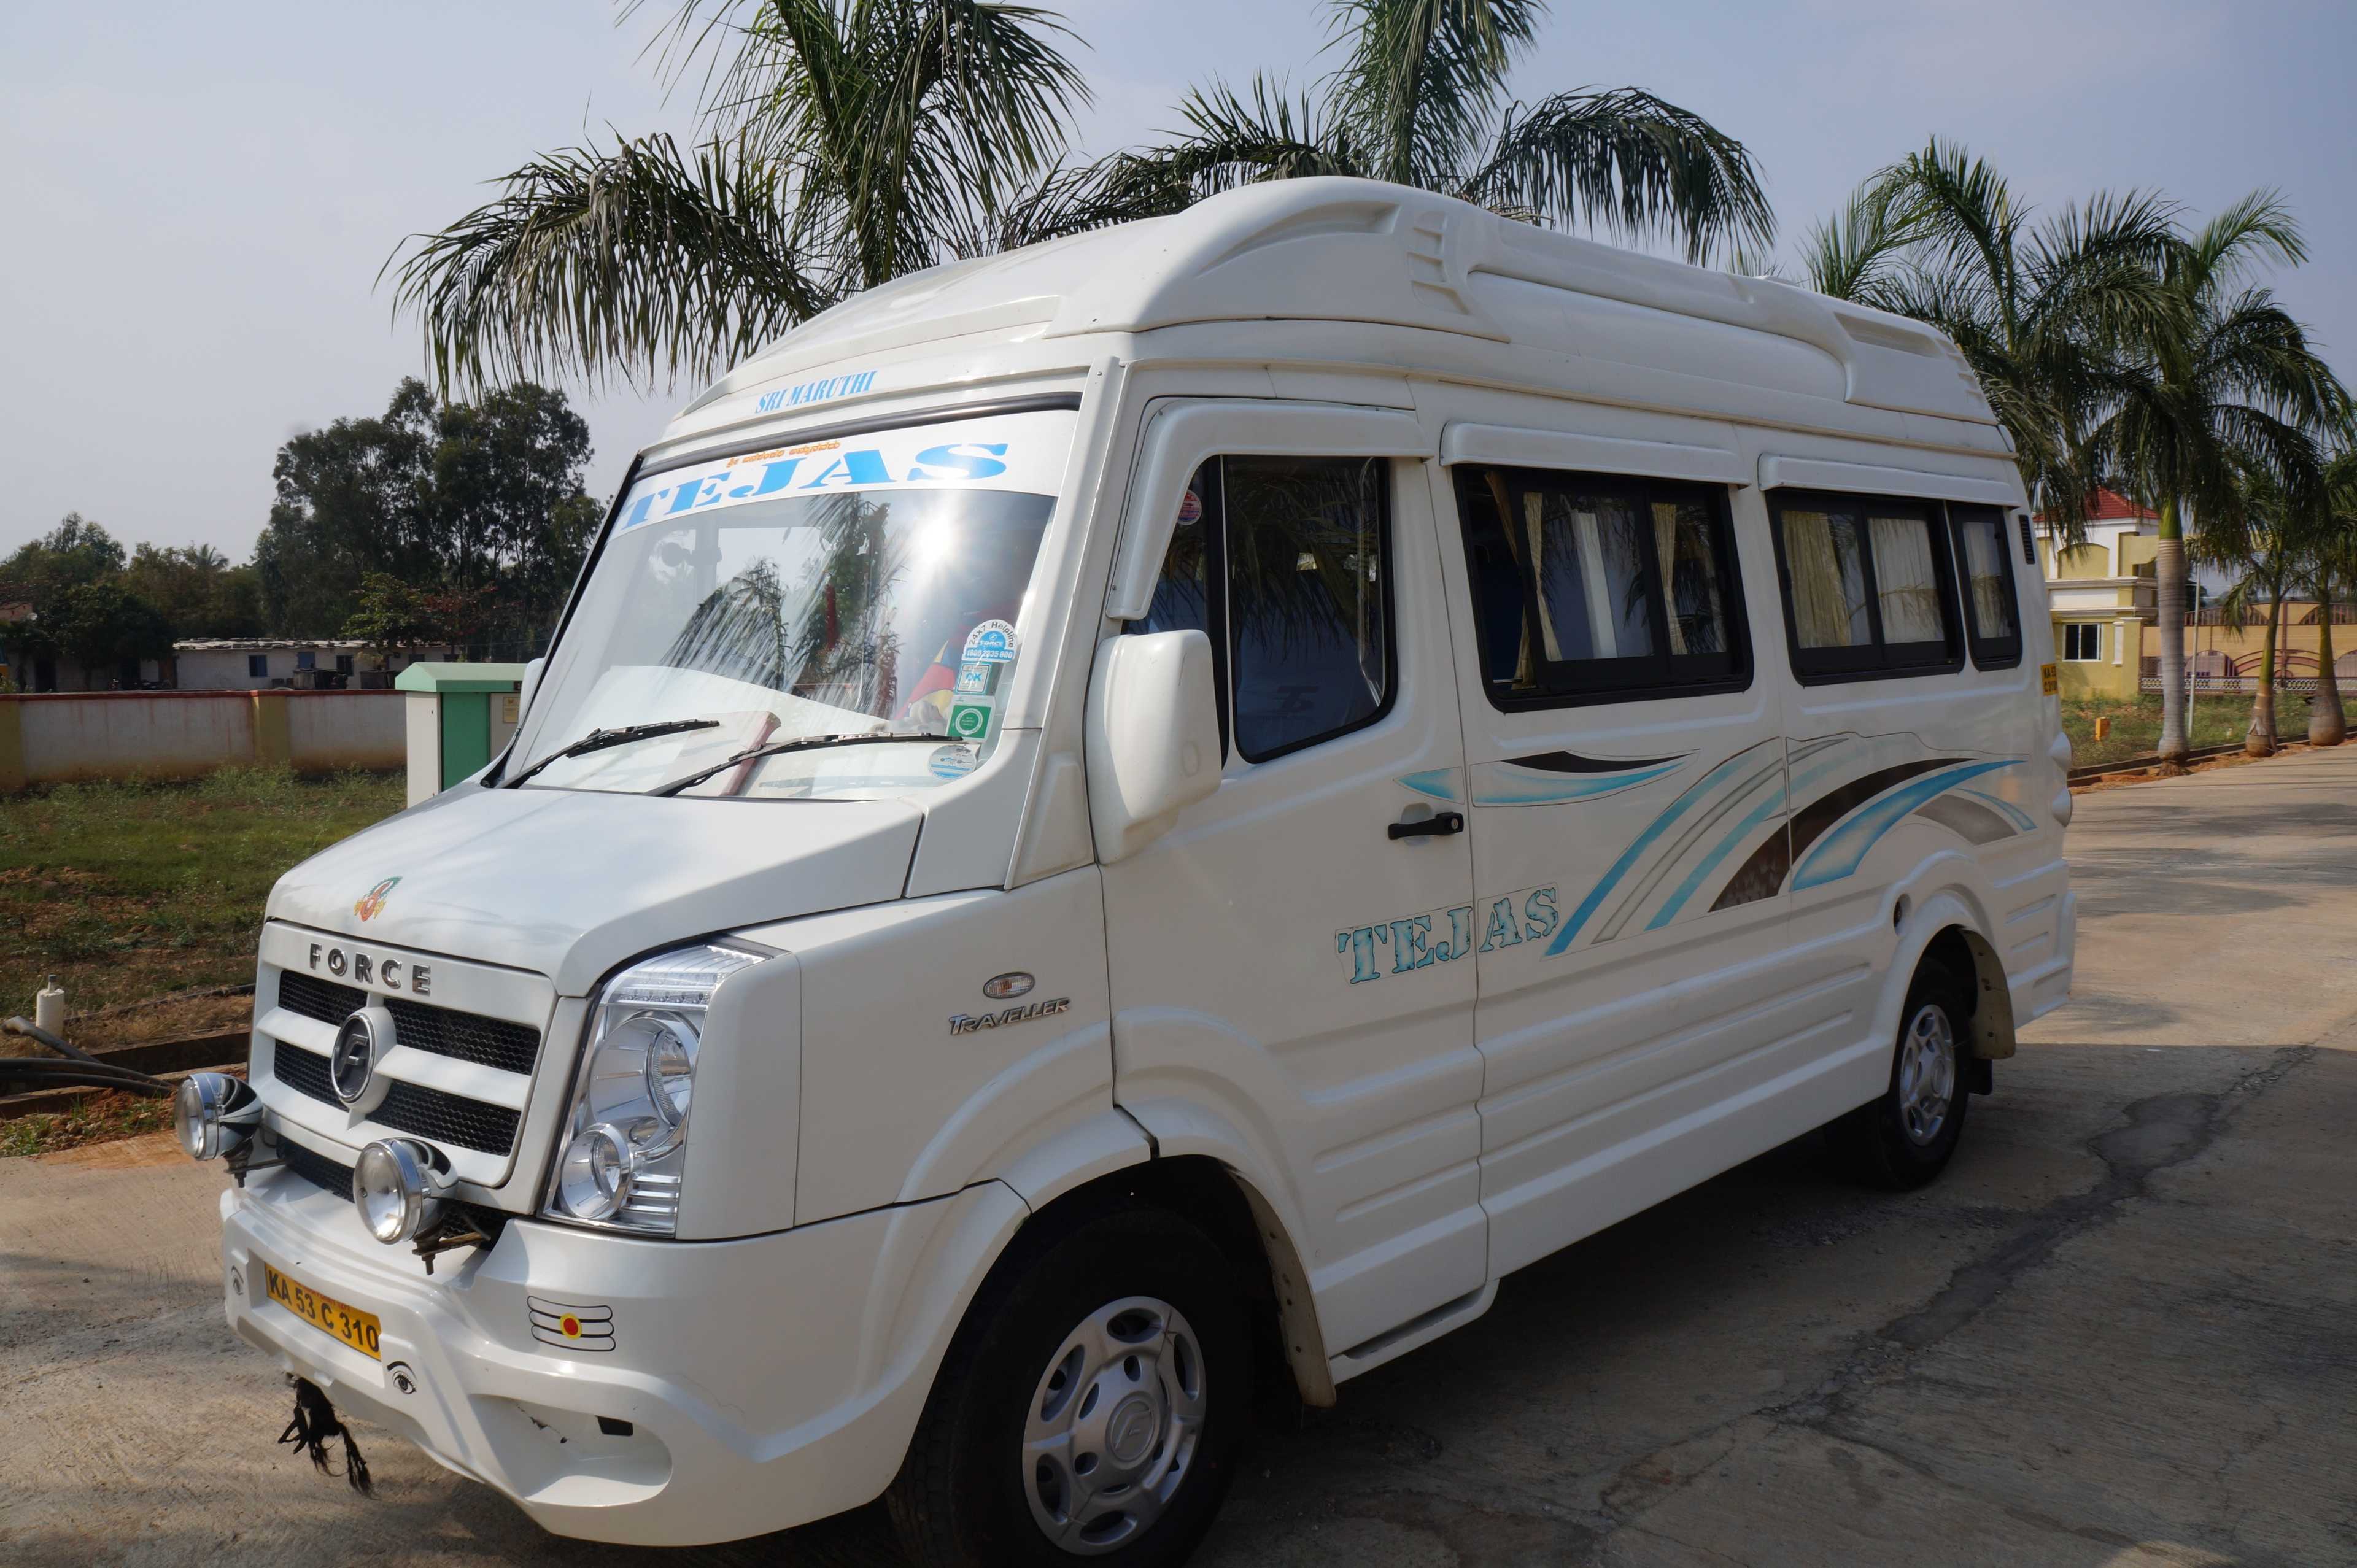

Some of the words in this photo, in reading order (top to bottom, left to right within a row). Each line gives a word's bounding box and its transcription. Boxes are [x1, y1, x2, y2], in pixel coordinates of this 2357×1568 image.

[756, 388, 788, 414] SRI
[786, 370, 878, 406] MARUTHI
[621, 442, 1009, 531] TEJAS
[991, 622, 1014, 648] Helpline
[1337, 887, 1559, 984] TEJAS
[309, 943, 431, 995] FORCE
[949, 997, 1070, 1035] TRAVELLER
[268, 1269, 292, 1307] KA
[295, 1286, 316, 1320] 53
[321, 1302, 334, 1330] C
[339, 1311, 379, 1353] 310
